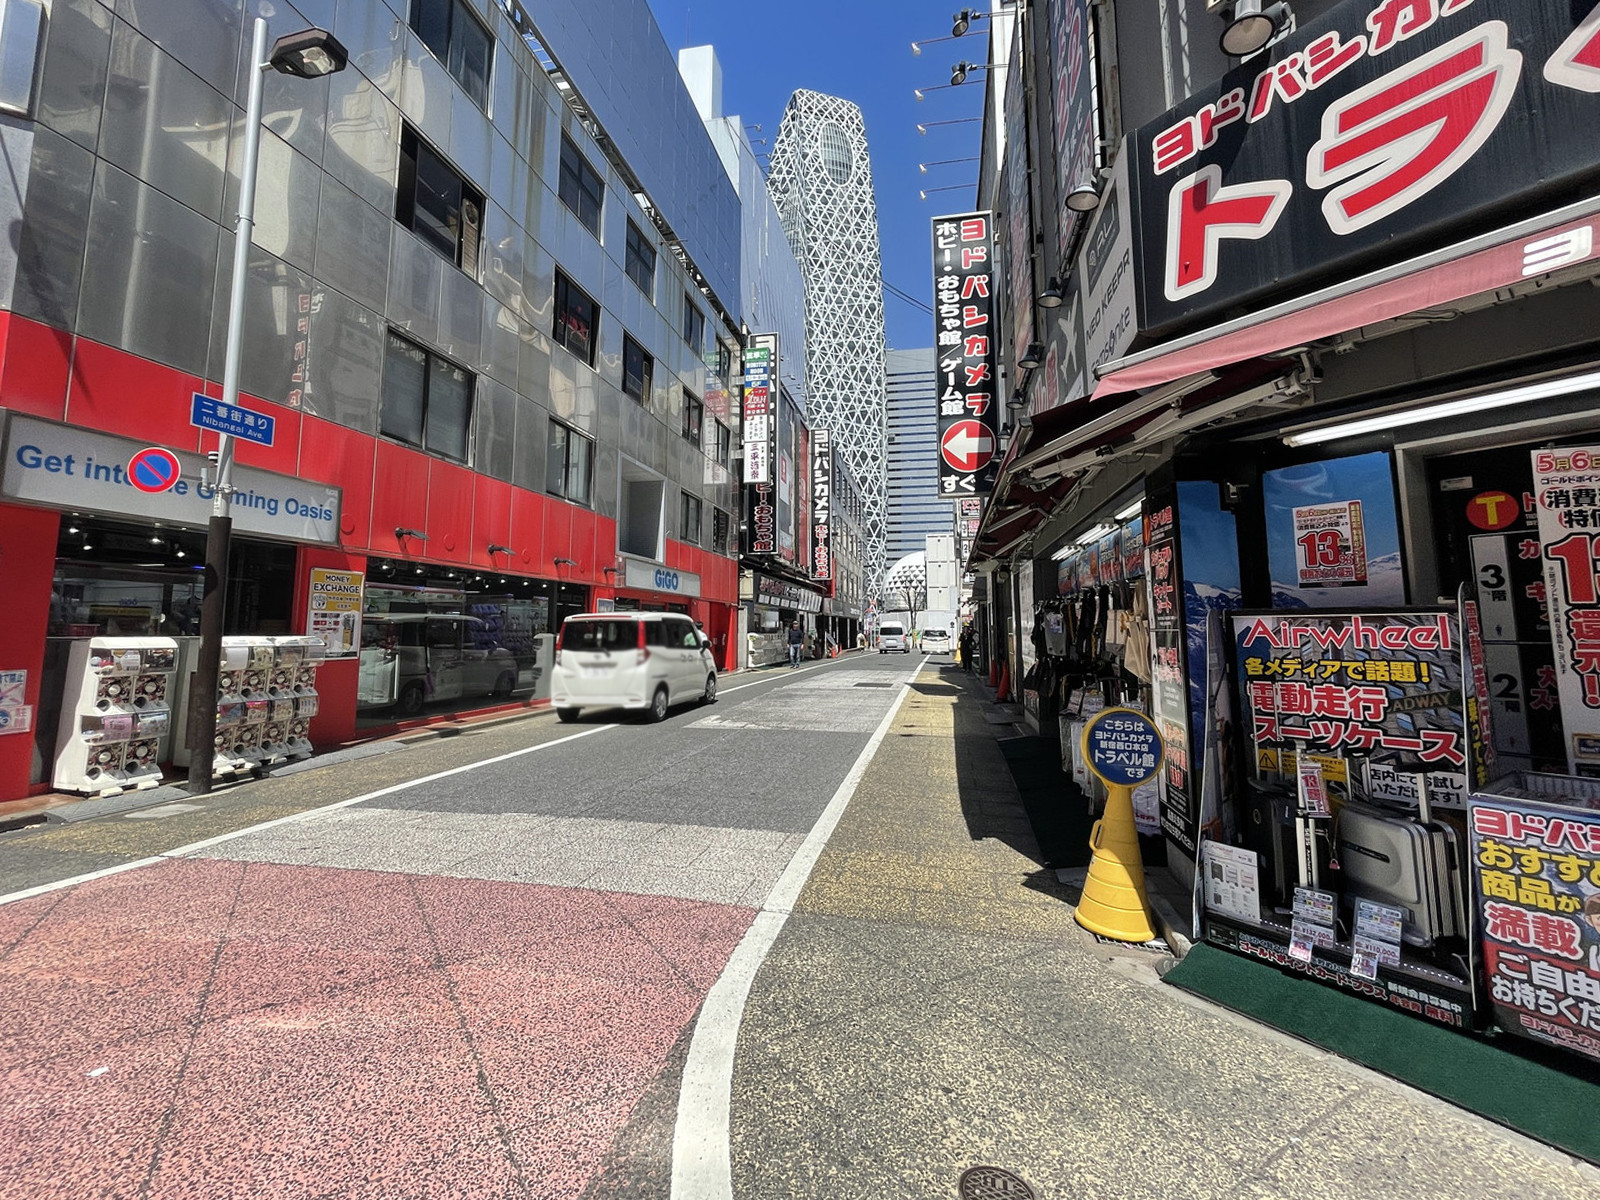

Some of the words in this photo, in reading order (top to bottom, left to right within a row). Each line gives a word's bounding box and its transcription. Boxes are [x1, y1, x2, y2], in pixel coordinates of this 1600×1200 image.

[1164, 5, 1600, 302] トラ
[1522, 225, 1592, 276] ヨ
[960, 218, 991, 417] ヨドバシカメラ
[201, 401, 268, 430] 二番街通り
[202, 416, 244, 433] Nibangai
[247, 429, 265, 440] Ave.
[16, 445, 75, 475] Get
[197, 483, 278, 516] Gming
[284, 497, 333, 521] Oasis
[814, 431, 829, 523] ヨドバシカメラ
[941, 475, 976, 493] すぐ
[1475, 495, 1506, 525] T
[1546, 488, 1600, 509] 消費
[754, 483, 774, 551] ビー・おもちゃ館
[325, 574, 350, 583] MONEY
[1545, 532, 1600, 605] 1
[313, 583, 360, 594] EXCHANGE
[1242, 614, 1451, 649] Airwheel
[1244, 657, 1431, 683] 各メディアで話題!
[1251, 680, 1388, 722] 電動走行
[1095, 731, 1154, 743] ヨドバシカメラ
[1104, 720, 1145, 732] こちらは
[1253, 715, 1465, 765] スーツケース
[1095, 749, 1155, 767] トラベル館
[1100, 741, 1149, 752] 新宿西口本店
[1125, 768, 1146, 778] です
[1479, 839, 1600, 887] おすす
[1480, 868, 1582, 913] 商品が
[1483, 901, 1585, 960] 満載
